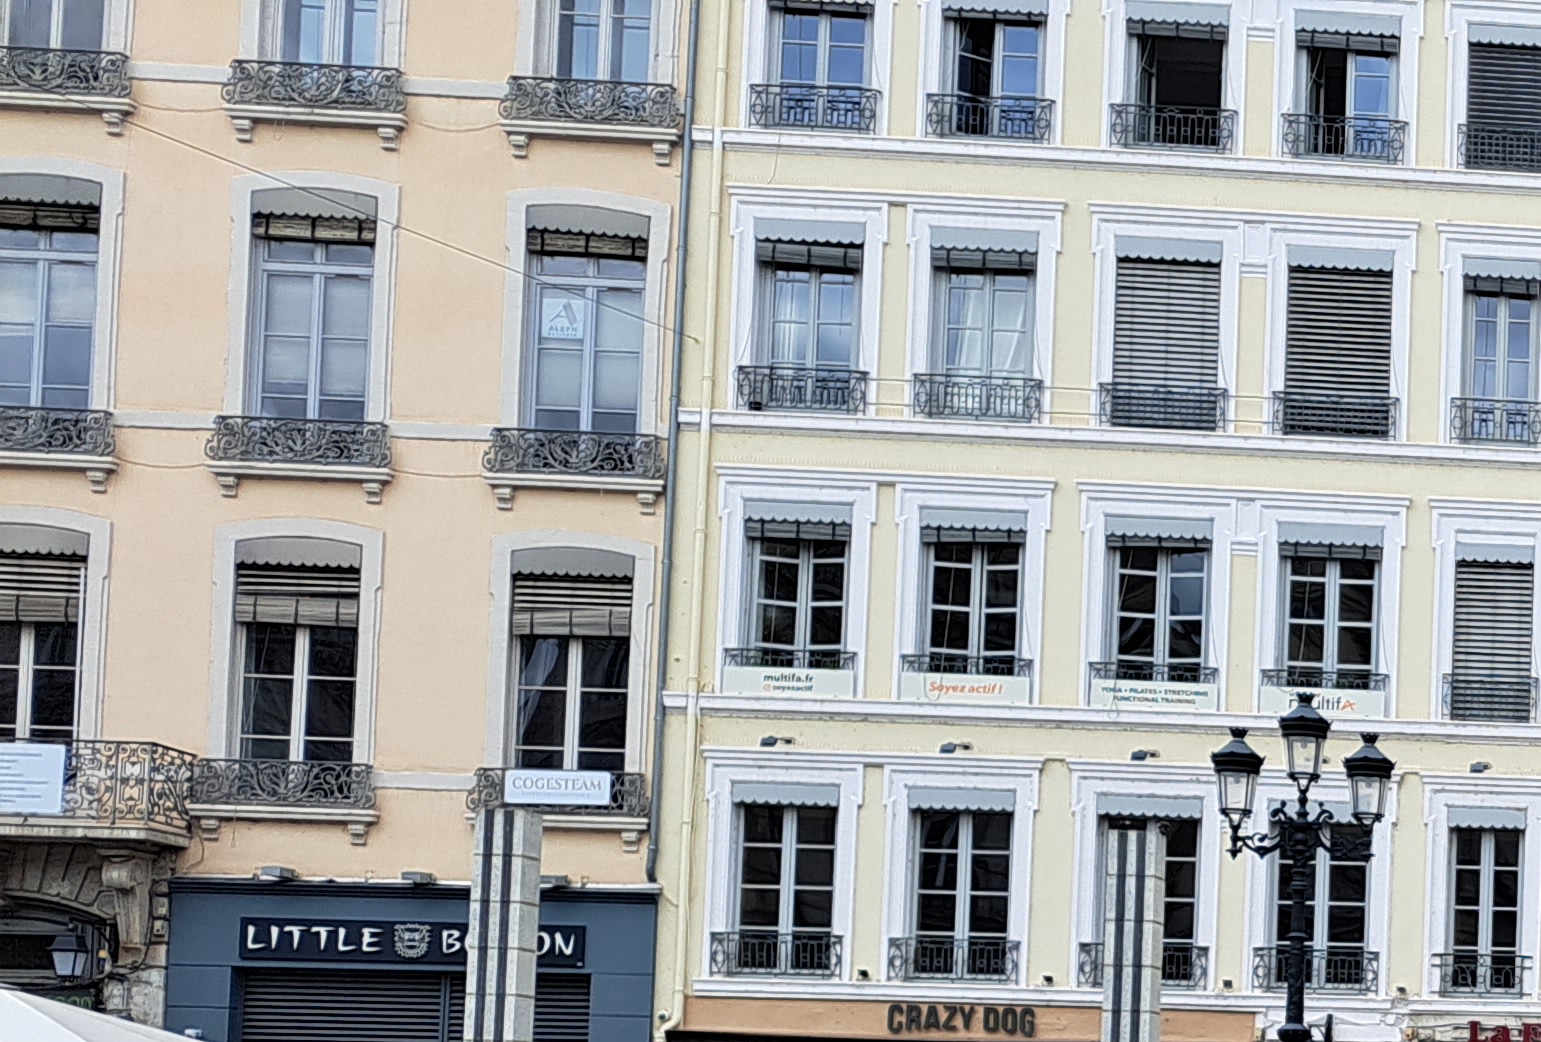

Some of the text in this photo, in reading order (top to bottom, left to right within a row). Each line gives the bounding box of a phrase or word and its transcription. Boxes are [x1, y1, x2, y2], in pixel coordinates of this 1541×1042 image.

[763, 673, 814, 683] multifa.fr
[928, 681, 964, 694] Soyez
[967, 682, 994, 694] actif
[513, 776, 601, 791] COGESTEAM
[246, 925, 384, 953] LITTLE
[887, 1003, 1036, 1037] CRAZY DOG
